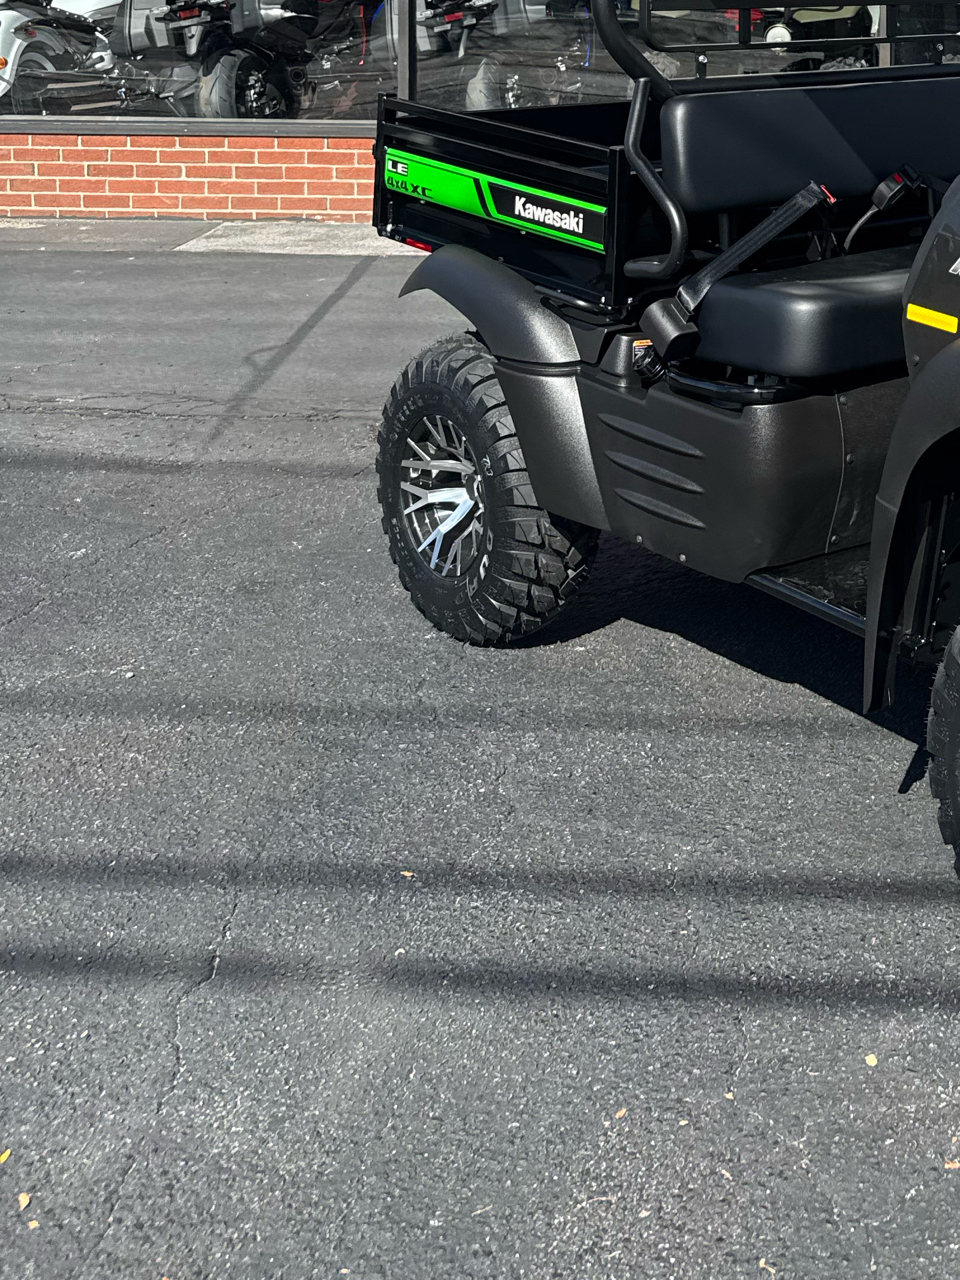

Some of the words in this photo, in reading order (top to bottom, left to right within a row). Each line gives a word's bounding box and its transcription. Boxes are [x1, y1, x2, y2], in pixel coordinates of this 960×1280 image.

[387, 160, 408, 175] LE
[409, 183, 434, 199] XC
[514, 195, 584, 234] Kawasaki
